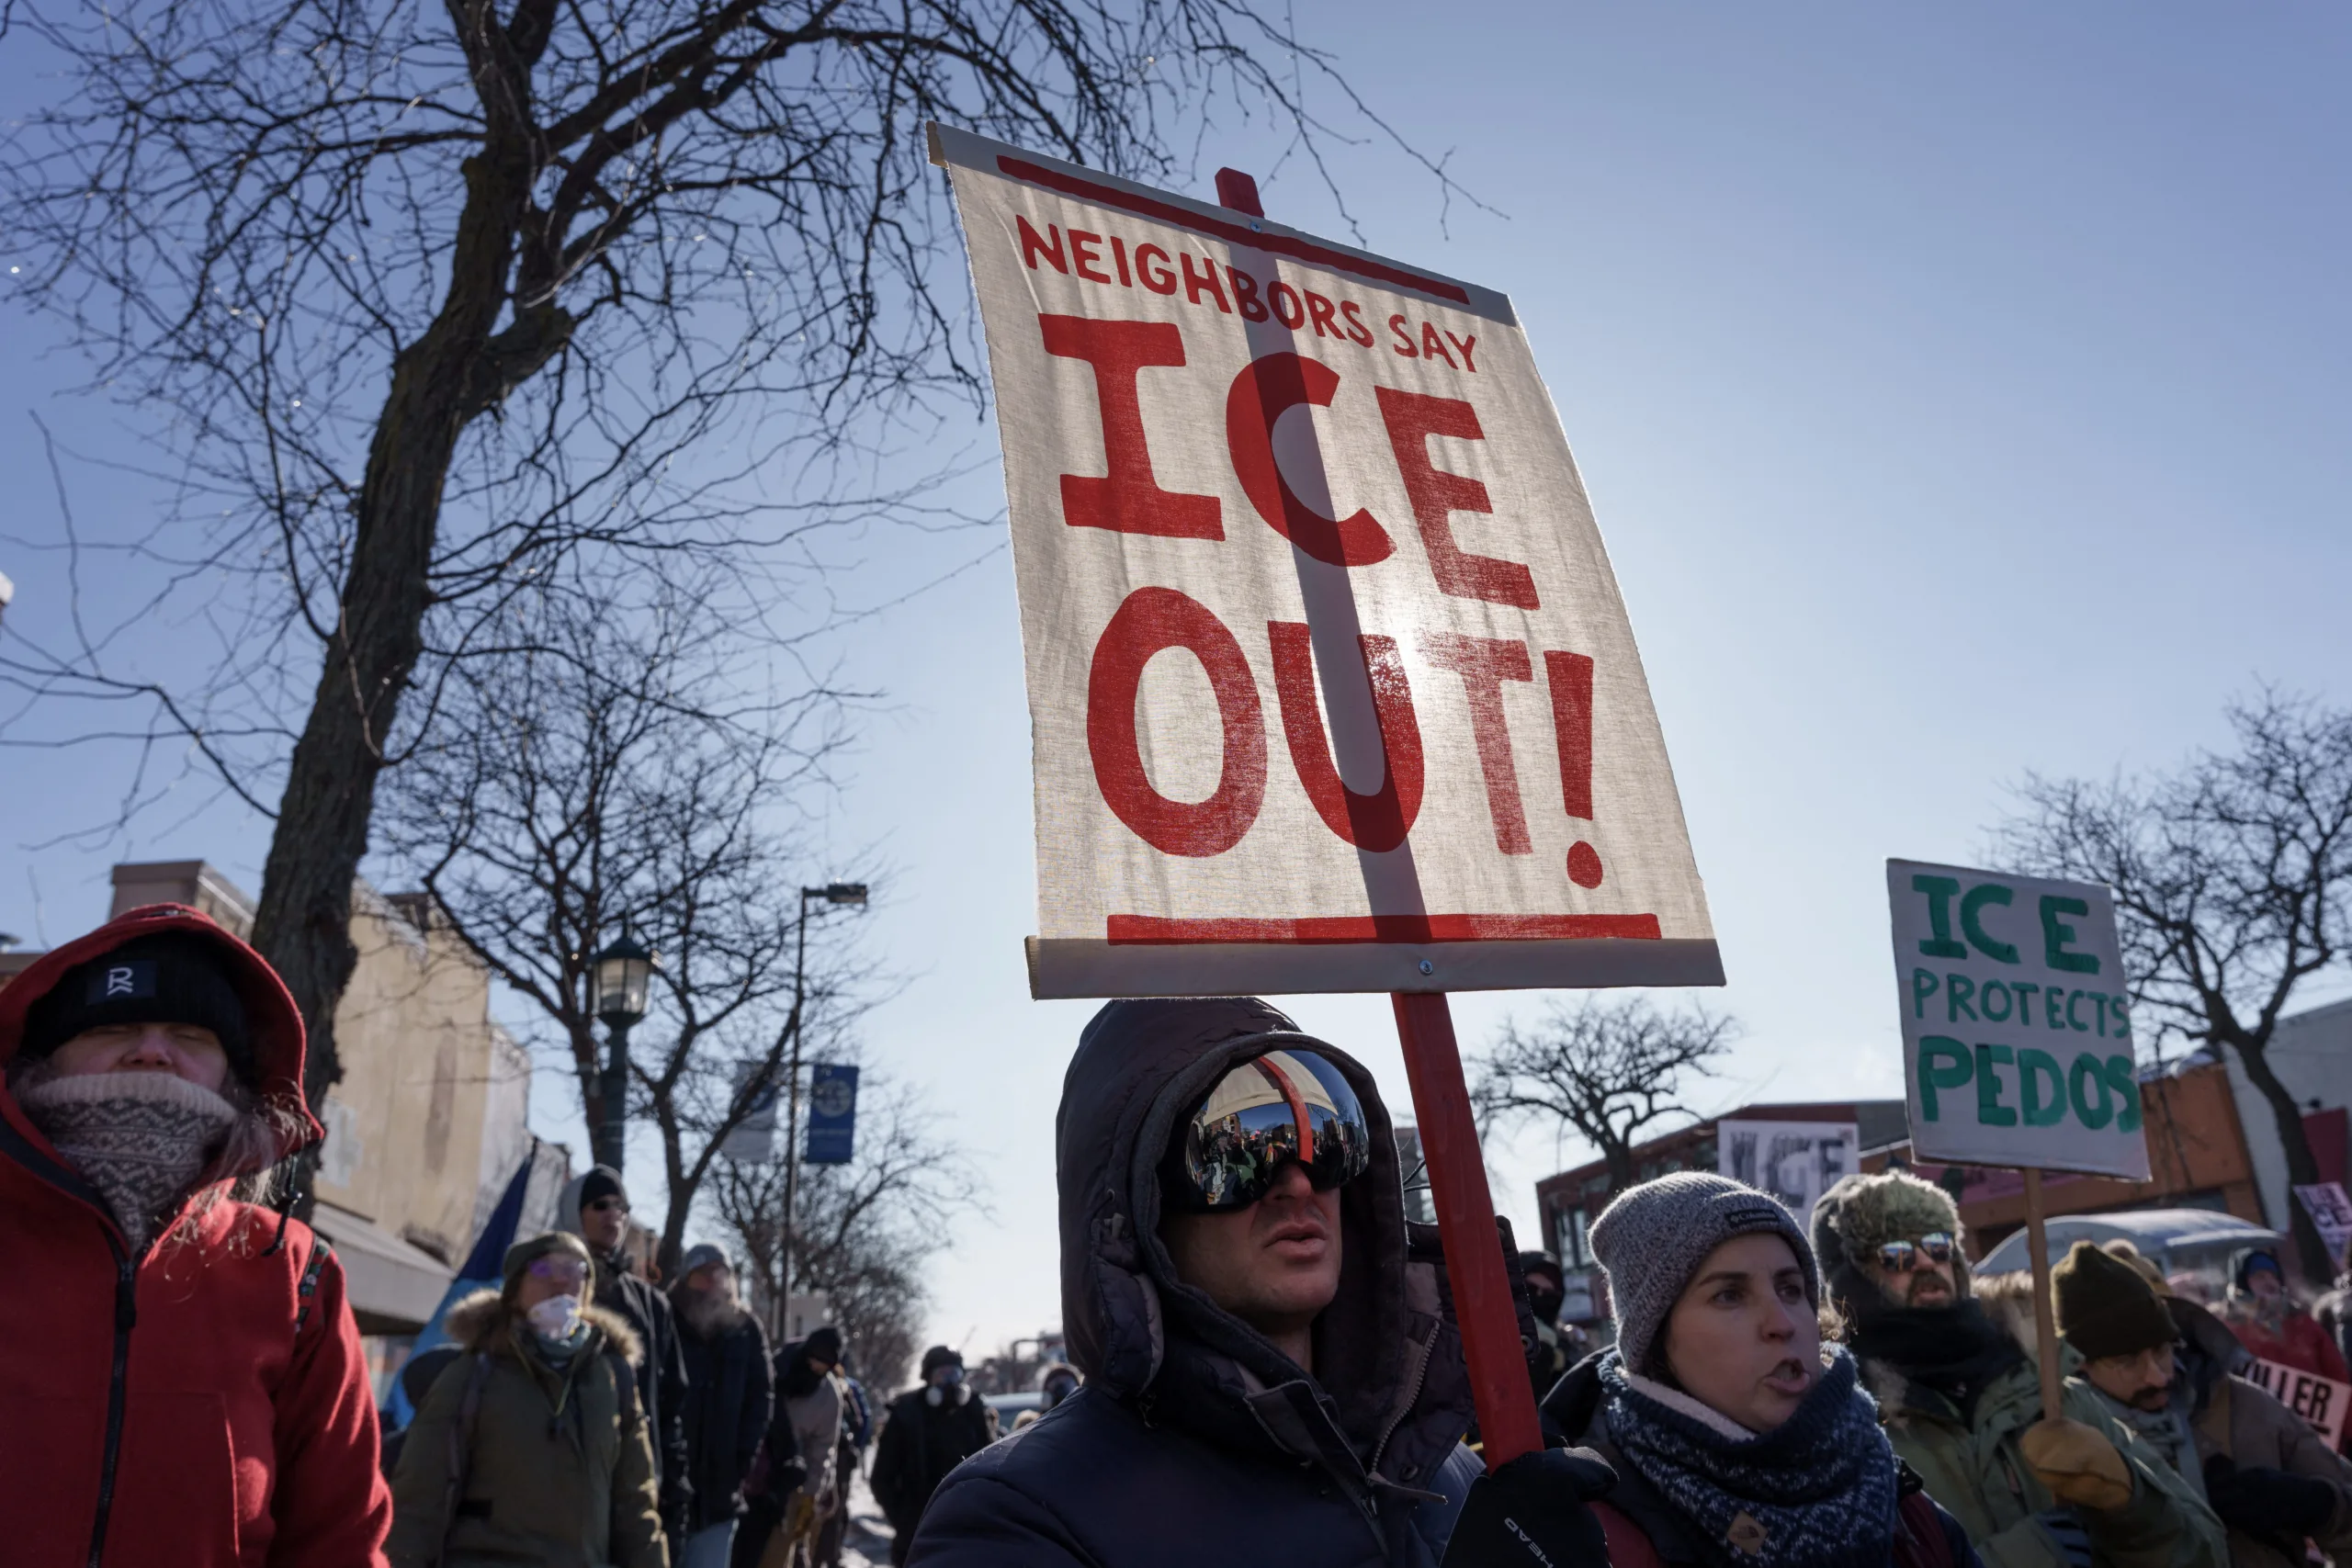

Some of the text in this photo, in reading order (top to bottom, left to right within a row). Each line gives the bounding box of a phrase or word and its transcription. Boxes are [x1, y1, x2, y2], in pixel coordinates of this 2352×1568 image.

[1015, 214, 1477, 374] NEIGHBORS SAY
[1038, 312, 1541, 611] ICE
[1087, 585, 1604, 890] OUT!
[1912, 874, 2101, 976] ICE
[1913, 967, 2131, 1039] PROTECTS
[1917, 1035, 2143, 1134] PEDOS
[1504, 1517, 1554, 1568] HEAD
